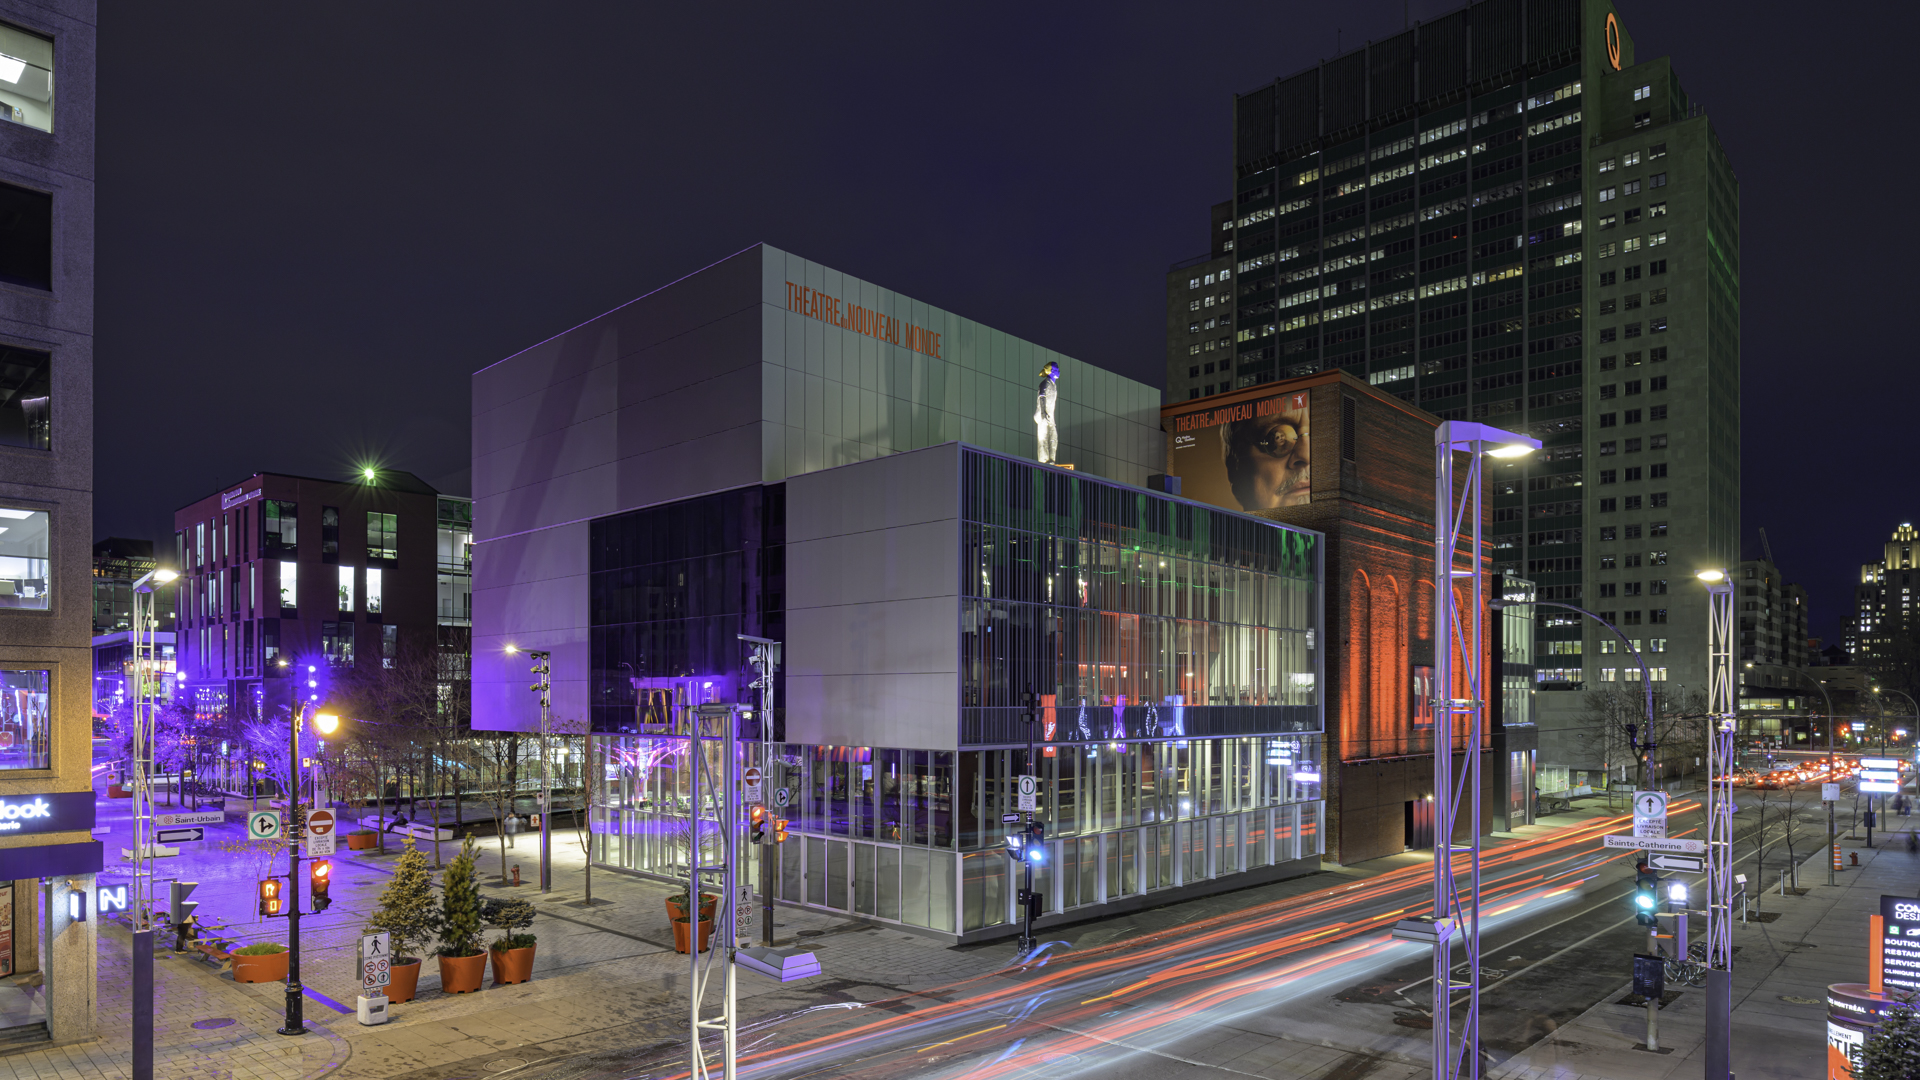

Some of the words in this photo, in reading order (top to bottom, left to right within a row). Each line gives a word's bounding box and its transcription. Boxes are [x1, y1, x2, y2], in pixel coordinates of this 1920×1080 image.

[840, 314, 848, 329] du
[848, 302, 900, 346] NOUVEAU
[905, 322, 942, 359] MONDE
[1214, 404, 1252, 424] NOUVEAU
[1256, 396, 1287, 418] MONDE
[175, 815, 221, 824] Saint-Urbain
[1608, 839, 1681, 850] Sainte-Catherine
[99, 887, 126, 911] N
